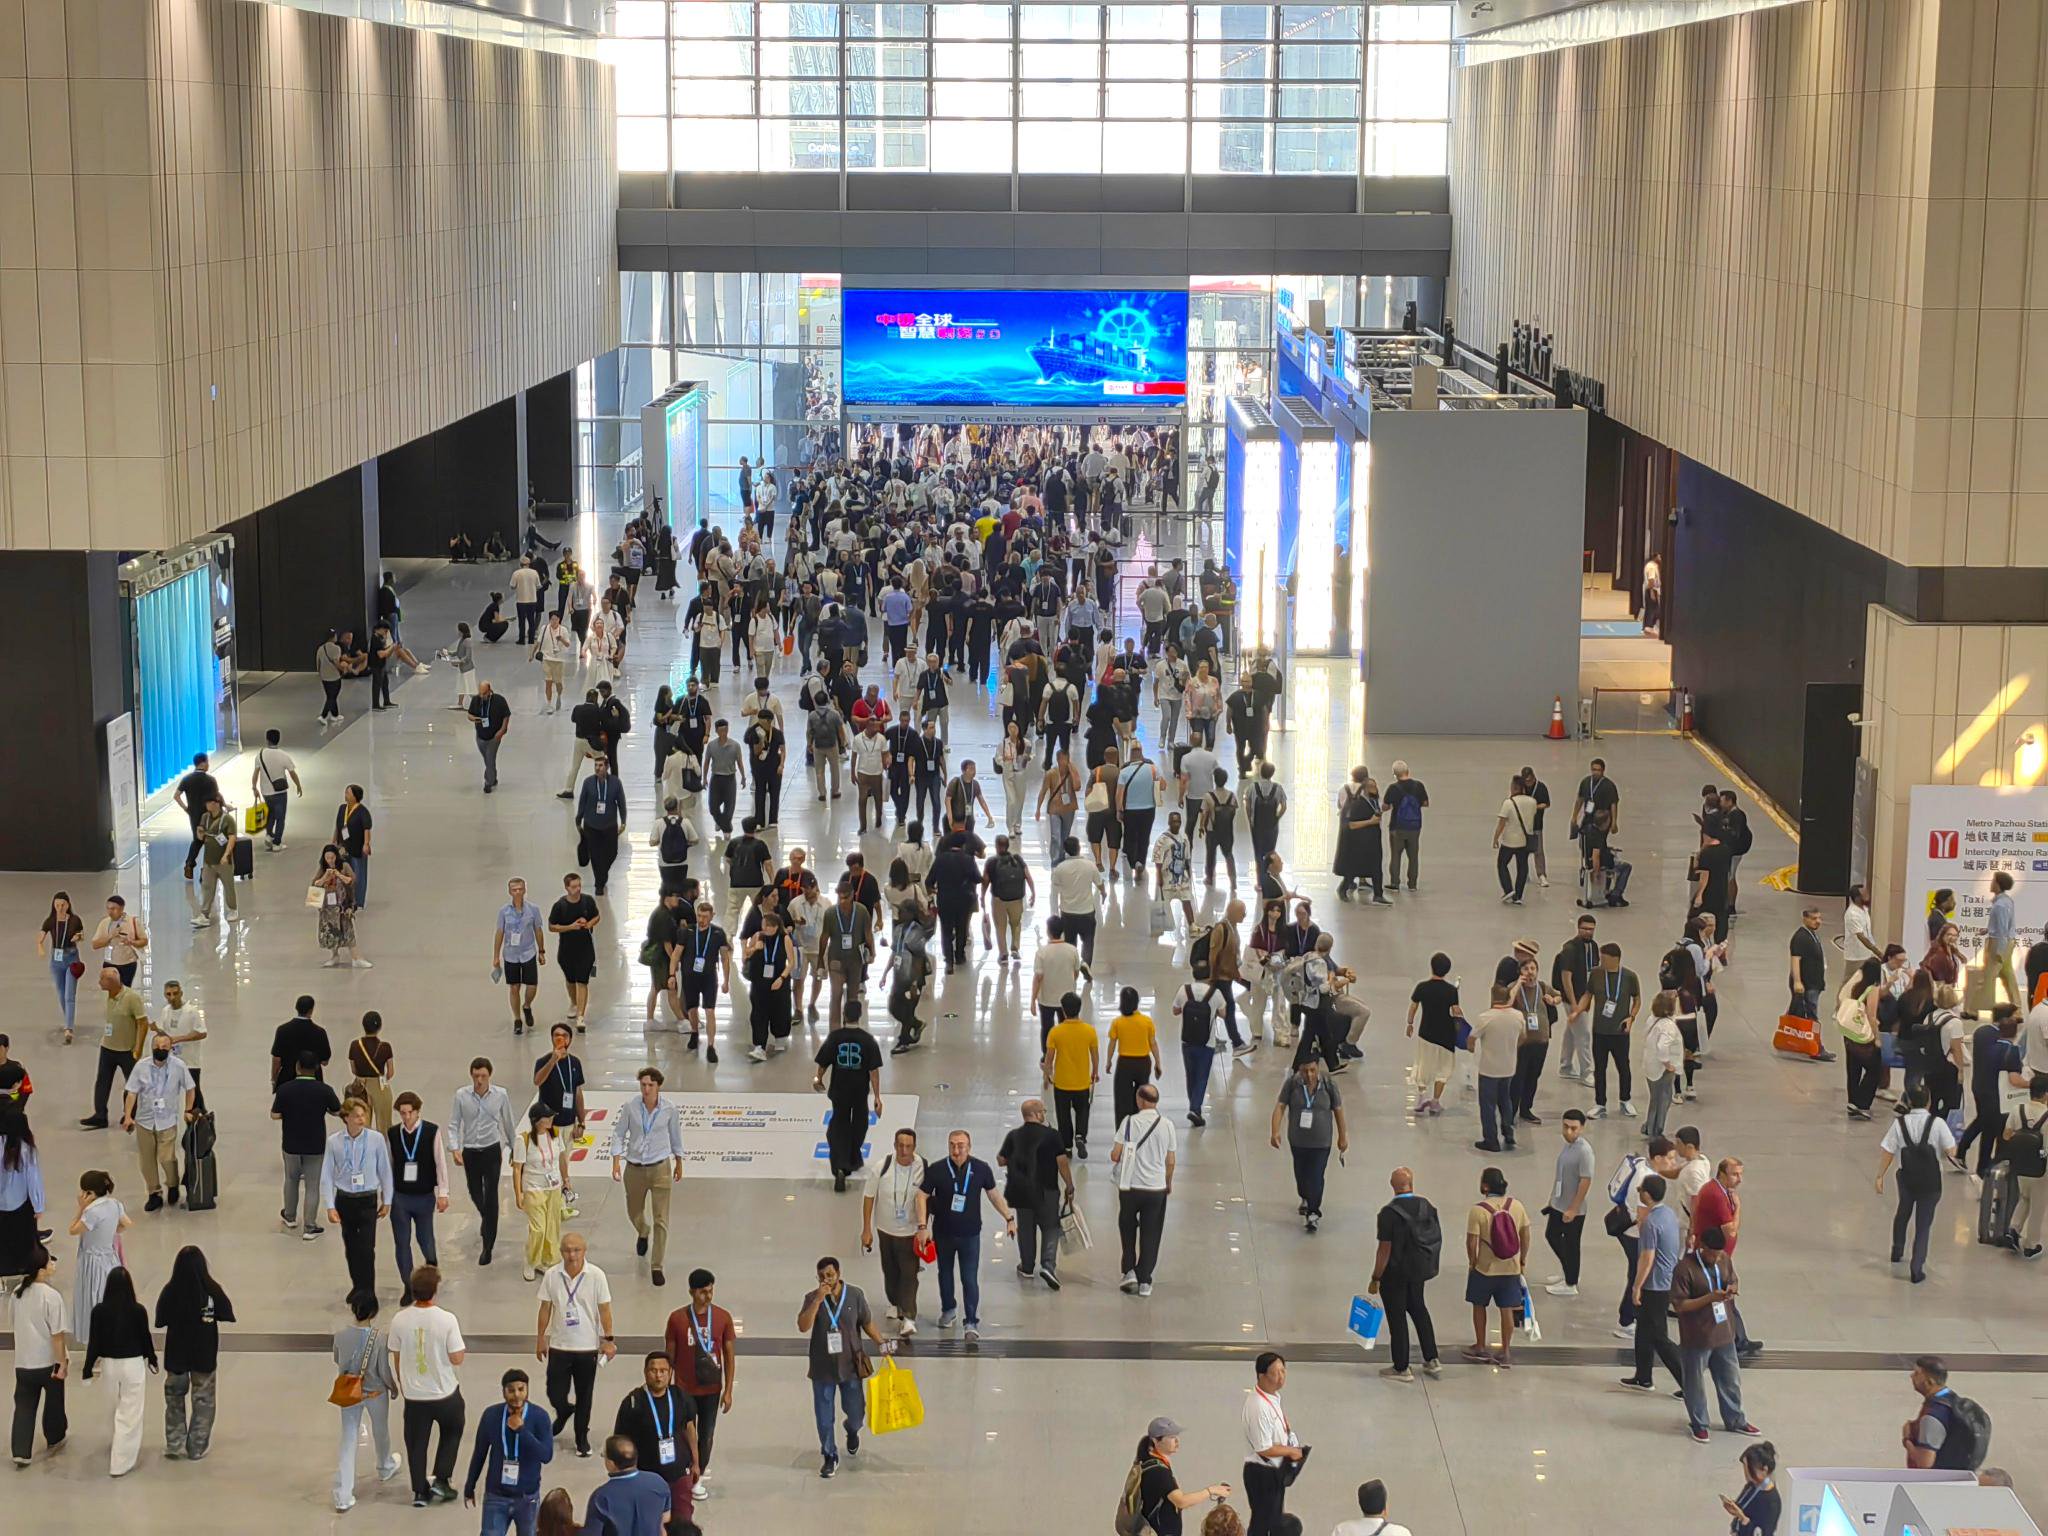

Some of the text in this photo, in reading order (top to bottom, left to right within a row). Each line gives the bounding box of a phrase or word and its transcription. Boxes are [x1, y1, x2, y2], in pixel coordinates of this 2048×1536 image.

[1966, 819, 1993, 828] Metro
[1995, 819, 2026, 828] Pazhou
[1965, 848, 2000, 858] Intercity
[2002, 848, 2034, 857] Pazhou
[1963, 895, 1984, 904] Taxi
